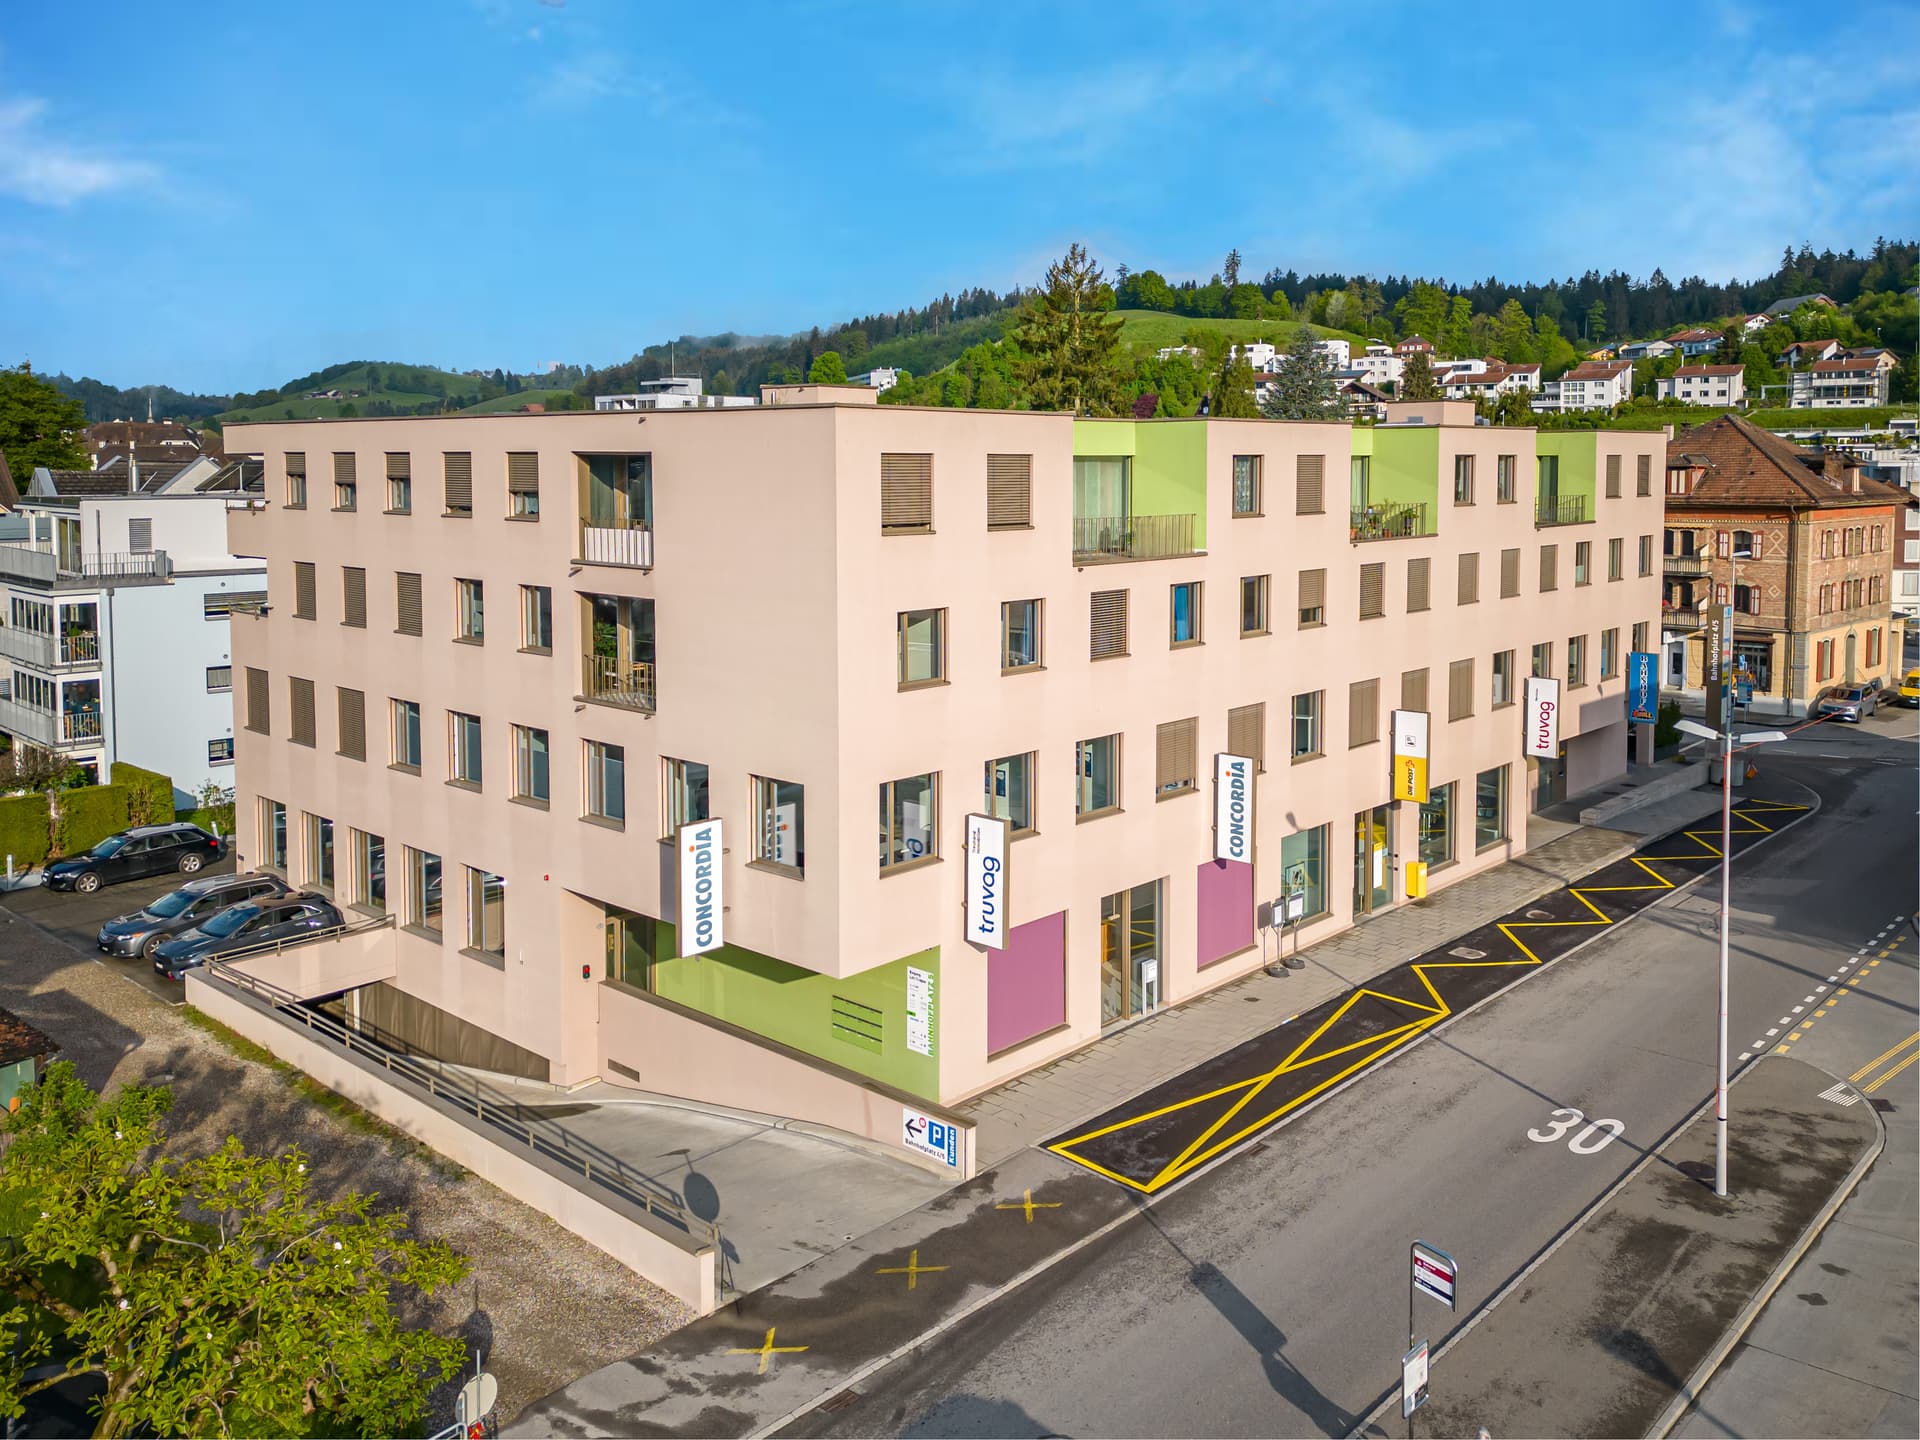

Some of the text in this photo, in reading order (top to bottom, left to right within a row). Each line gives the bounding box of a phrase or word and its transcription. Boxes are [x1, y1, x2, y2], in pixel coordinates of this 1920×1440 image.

[1710, 619, 1720, 681] Bahnhofplatz 4/5
[1536, 701, 1555, 749] truvag
[1226, 761, 1245, 858] CONCORDIA
[689, 827, 713, 947] CONCORDIA
[978, 856, 1001, 933] truvag
[932, 1125, 942, 1143] P
[1527, 1108, 1625, 1154] 30
